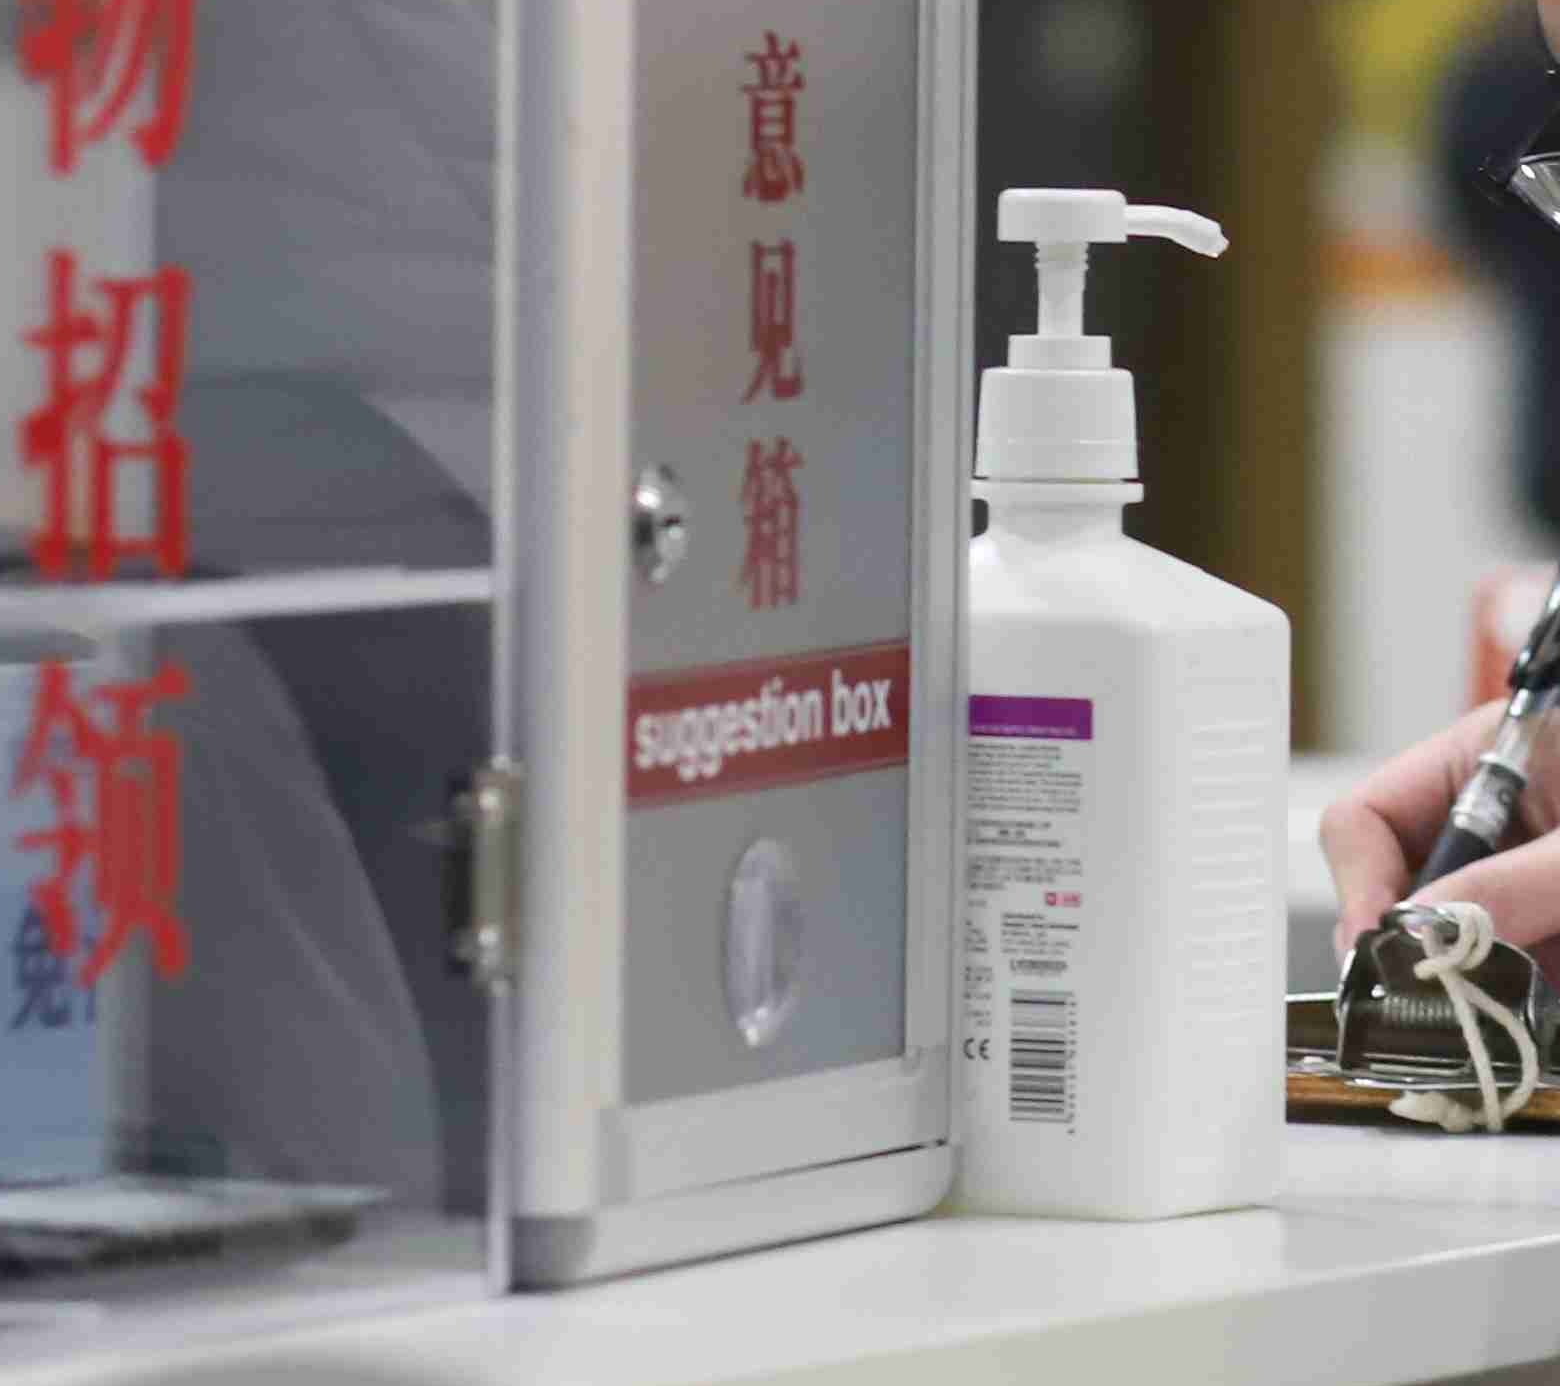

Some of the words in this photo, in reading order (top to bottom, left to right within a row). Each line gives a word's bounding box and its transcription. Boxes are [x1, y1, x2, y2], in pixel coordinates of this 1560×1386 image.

[741, 28, 805, 611] 意见箱
[635, 675, 824, 783] suggestion
[831, 667, 892, 738] box
